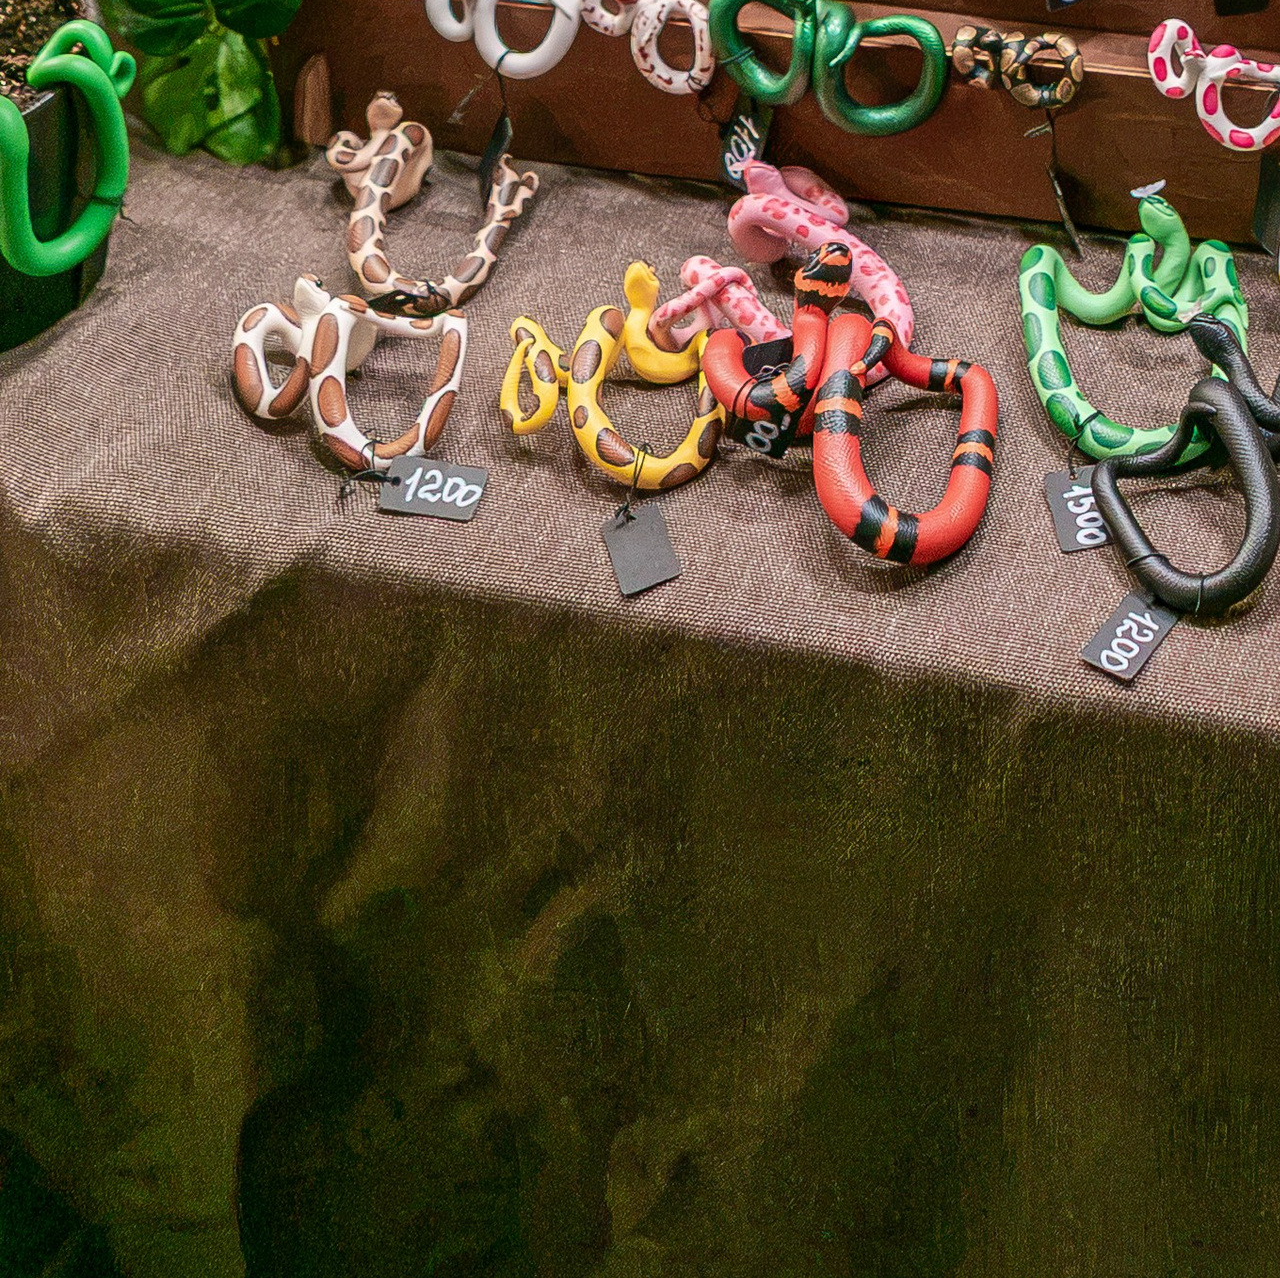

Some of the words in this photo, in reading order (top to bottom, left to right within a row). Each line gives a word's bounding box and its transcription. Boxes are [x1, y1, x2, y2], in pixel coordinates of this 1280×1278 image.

[403, 466, 484, 508] 1200
[1063, 483, 1107, 546] 1500
[1099, 611, 1160, 673] 1200
